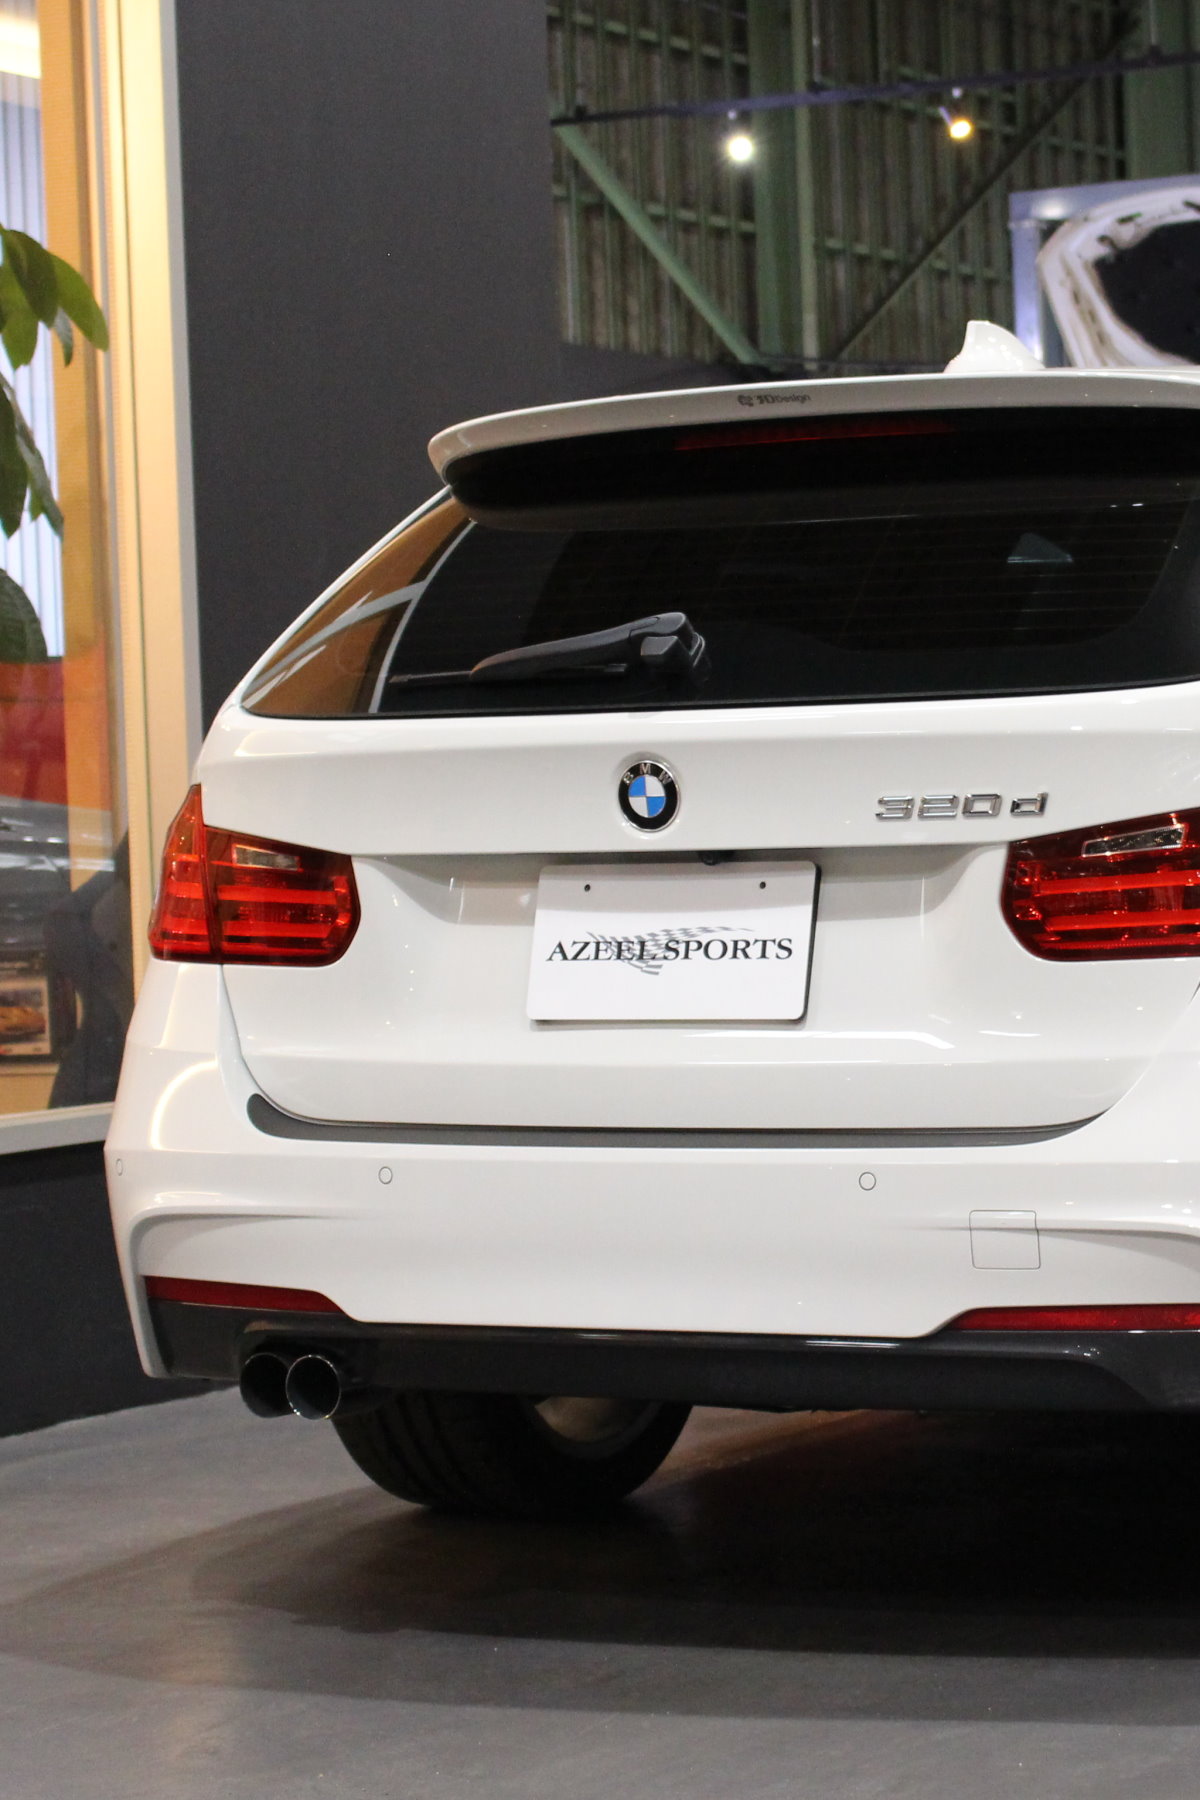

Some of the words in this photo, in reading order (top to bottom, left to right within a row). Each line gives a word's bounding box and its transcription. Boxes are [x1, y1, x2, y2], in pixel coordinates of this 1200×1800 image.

[623, 763, 672, 785] BMW
[875, 792, 1049, 820] 320d
[546, 939, 658, 962] AZEEL
[662, 937, 793, 960] SPORTS
